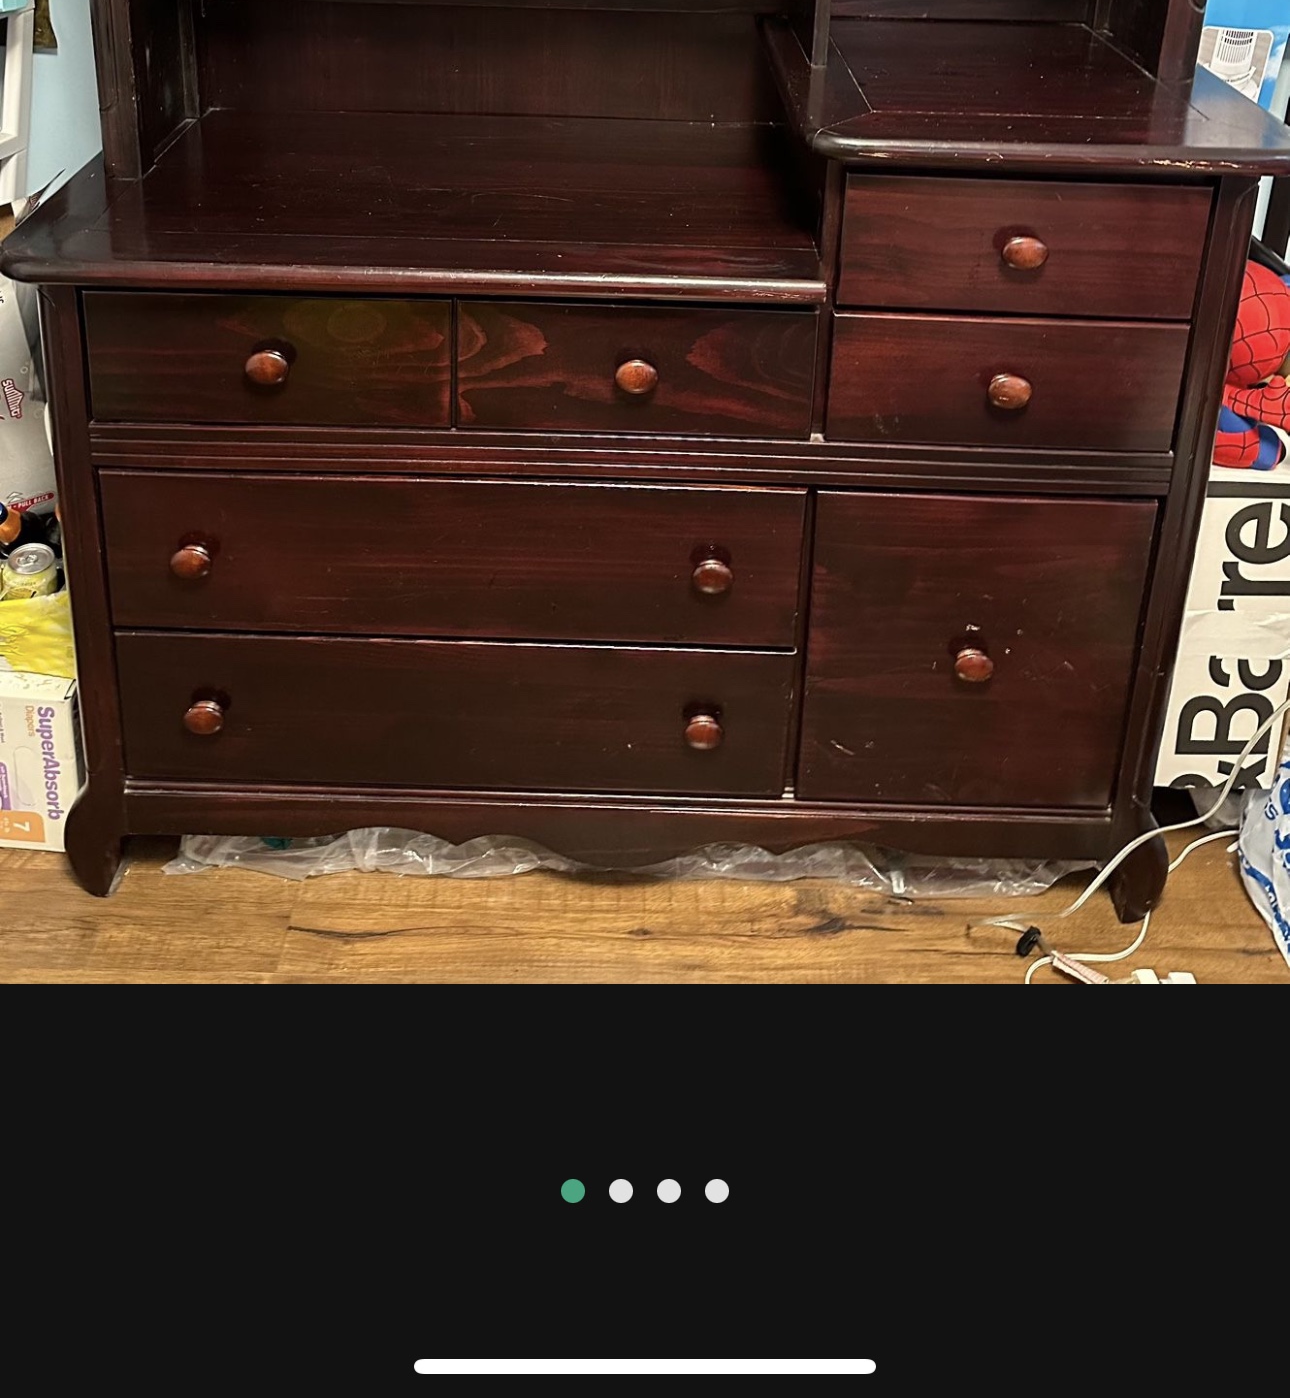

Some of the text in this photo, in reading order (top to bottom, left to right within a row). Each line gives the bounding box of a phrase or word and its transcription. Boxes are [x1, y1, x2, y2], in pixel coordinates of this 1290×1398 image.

[3, 379, 24, 417] summit
[18, 500, 32, 508] PULL
[33, 494, 50, 504] BACK
[25, 705, 35, 737] Diapers
[36, 706, 64, 820] SuperAbsorb
[13, 821, 31, 833] 7
